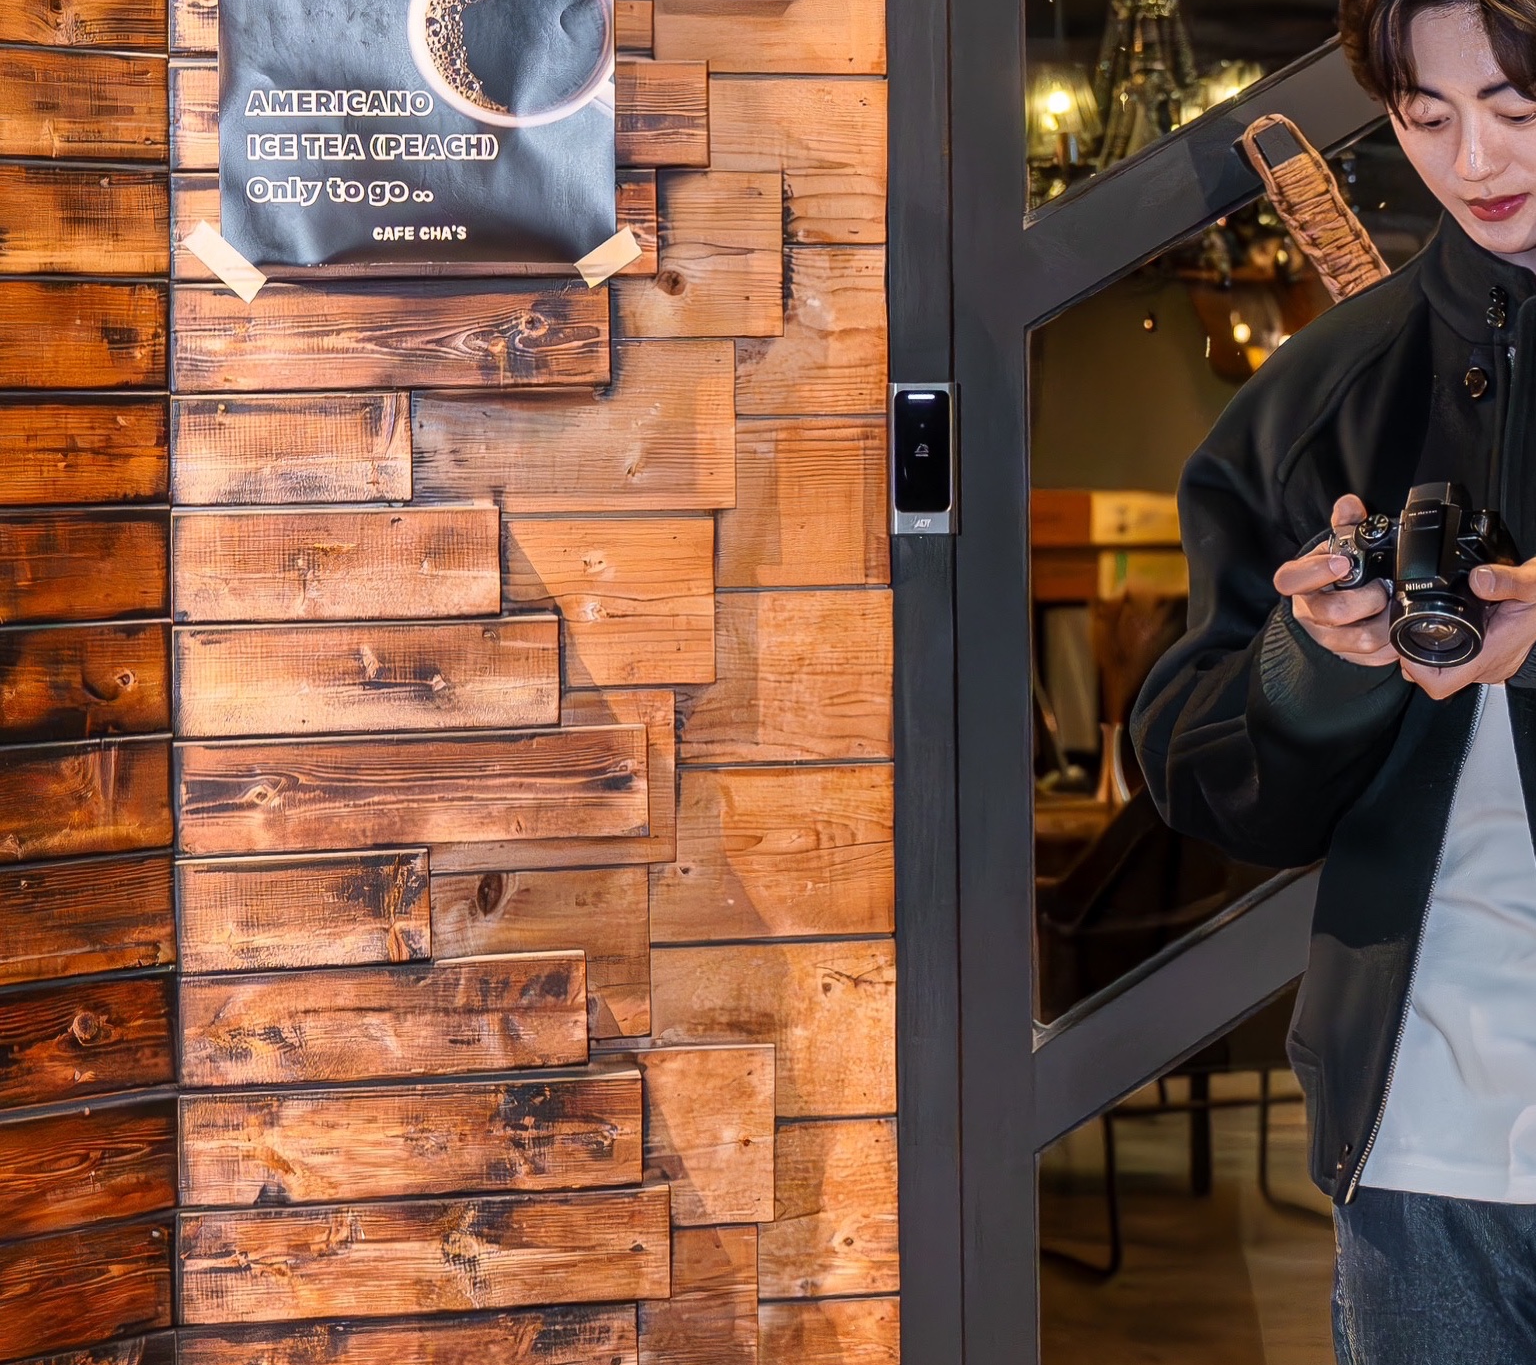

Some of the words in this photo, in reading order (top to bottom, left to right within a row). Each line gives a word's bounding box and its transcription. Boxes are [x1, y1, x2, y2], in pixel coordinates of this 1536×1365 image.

[244, 89, 434, 117] AMERICANO
[246, 133, 298, 161] ICE
[302, 133, 366, 161] TEA
[369, 133, 499, 161] (PEACH)
[246, 176, 322, 207] Only
[326, 177, 365, 203] to
[372, 226, 415, 241] CAFE
[418, 224, 468, 241] CHA'S
[1405, 581, 1433, 591] Nikon
